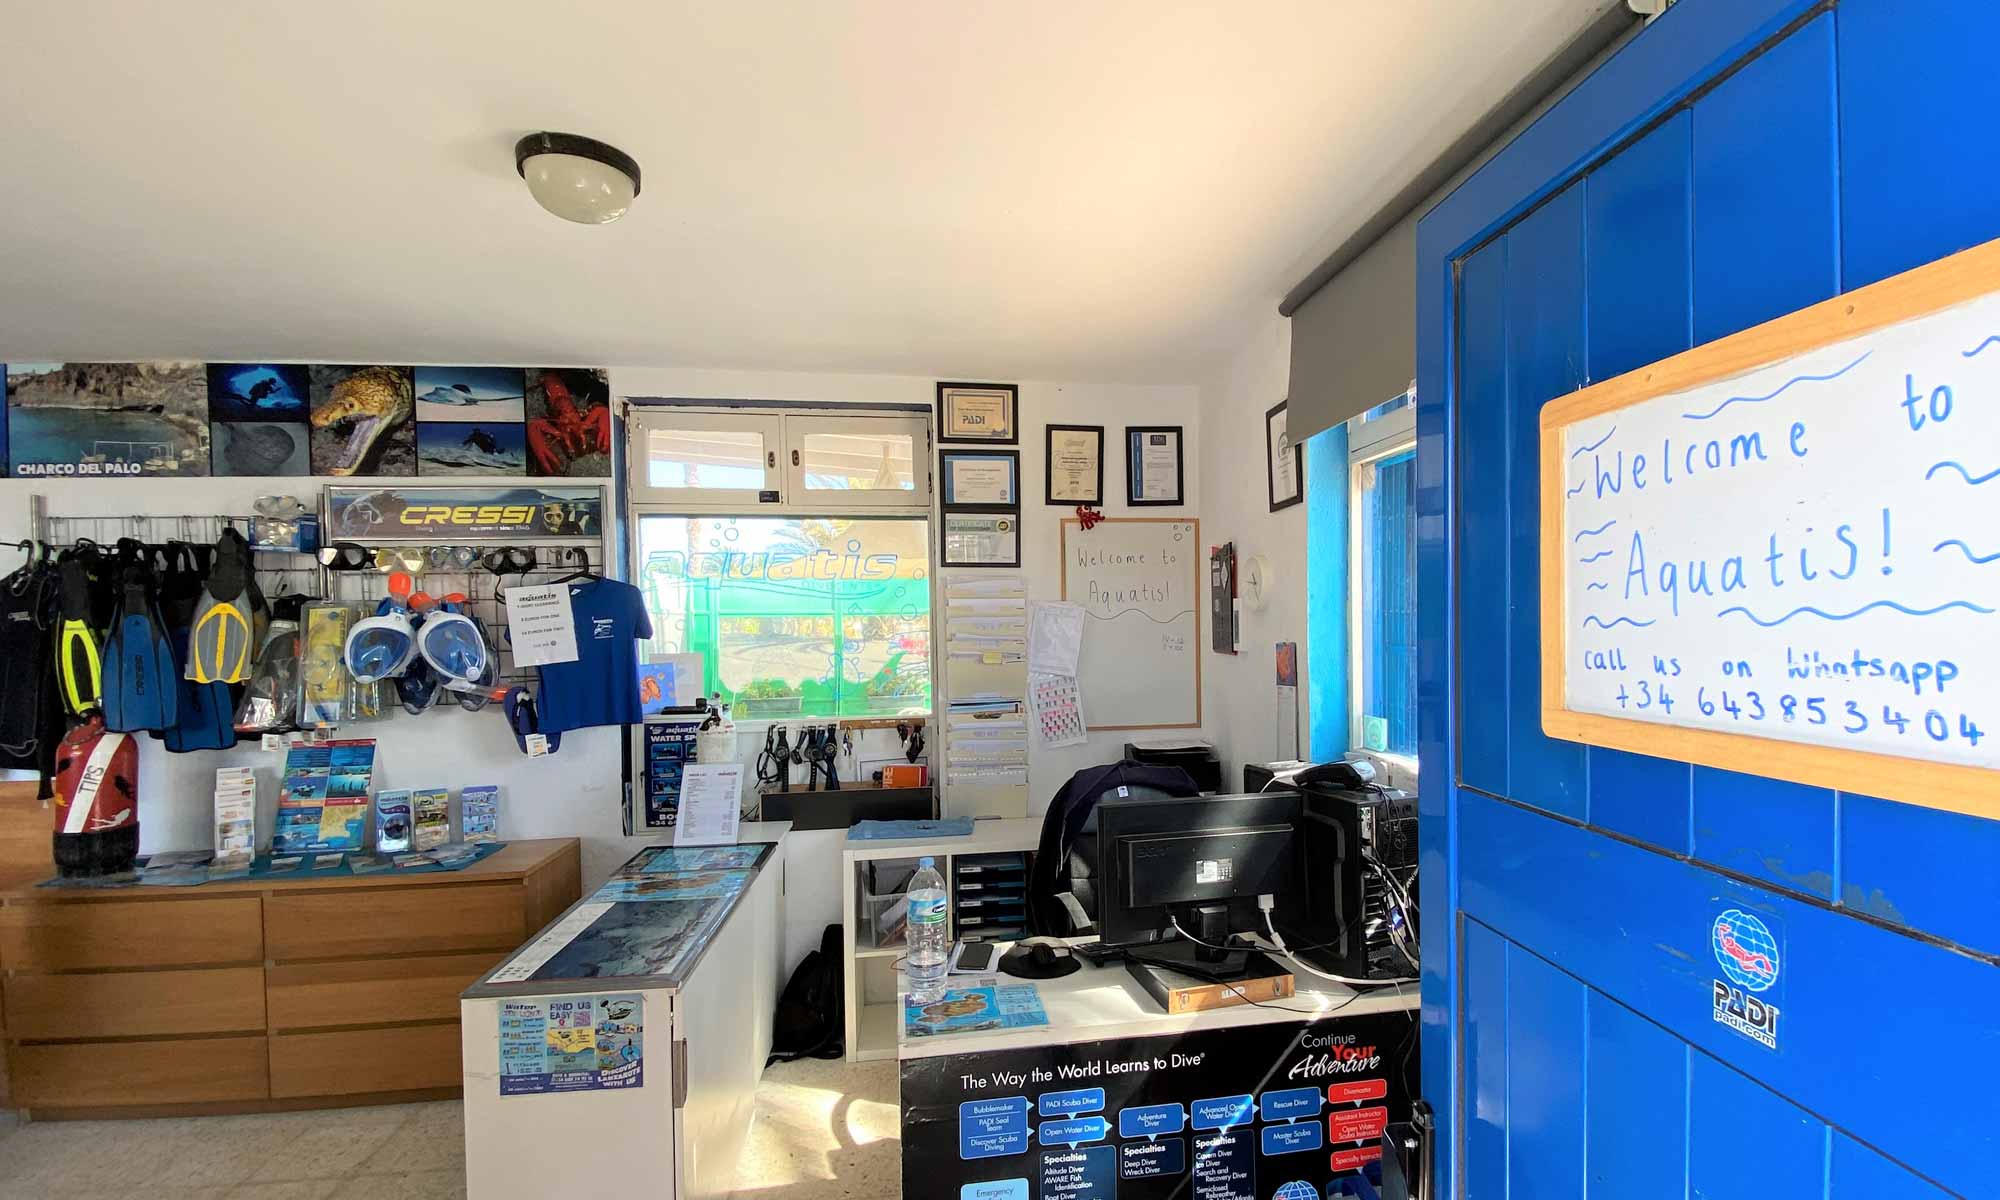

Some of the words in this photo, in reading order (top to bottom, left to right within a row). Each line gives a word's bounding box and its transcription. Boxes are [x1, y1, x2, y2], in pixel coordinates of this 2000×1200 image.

[962, 415, 986, 425] PADI
[1595, 421, 1808, 500] Welcome
[1900, 374, 1953, 432] to
[17, 463, 75, 475] CHARCO
[78, 463, 102, 474] DEL
[105, 462, 142, 474] PALO
[400, 506, 536, 524] CRESSI
[1077, 548, 1146, 567] Welcome
[1162, 548, 1176, 564] to
[643, 547, 899, 584] aquatis
[1088, 580, 1170, 612] Aquatis!
[1653, 655, 1682, 677] us
[1722, 660, 1753, 678] on
[1615, 680, 1675, 715] +34
[650, 735, 682, 743] WATER
[78, 765, 104, 793] TIPS
[550, 1002, 573, 1011] FIND
[577, 1001, 592, 1010] US
[1714, 980, 1777, 1036] PADI
[550, 1010, 572, 1020] EASY
[1714, 1010, 1776, 1049] padi.com
[1301, 1033, 1356, 1048] Continue
[1331, 1044, 1377, 1061] Your
[600, 1060, 638, 1077] DISCOVER
[1288, 1053, 1381, 1080] Adventure
[960, 1073, 987, 1089] The
[991, 1071, 1027, 1089] Way
[1031, 1066, 1053, 1083] the
[1057, 1060, 1101, 1079] World
[1105, 1059, 1150, 1074] Learns
[1153, 1057, 1167, 1070] to
[625, 1076, 636, 1085] US
[973, 1104, 1014, 1114] Bubblemaker
[1045, 1100, 1060, 1109] PADI
[1061, 1098, 1081, 1107] Scuba
[1082, 1097, 1098, 1105] Diver
[1273, 1101, 1293, 1109] Rescue
[1293, 1099, 1308, 1107] Diver
[1199, 1104, 1229, 1115] Advanced
[1206, 1111, 1224, 1120] Water
[978, 1118, 994, 1126] PADI
[995, 1115, 1009, 1124] Seal
[1137, 1113, 1167, 1121] Adventure
[1044, 1128, 1063, 1137] Open
[1063, 1126, 1083, 1134] Water
[1084, 1124, 1100, 1133] Diver
[1341, 1125, 1358, 1133] Open
[1359, 1121, 1376, 1131] Water
[970, 1138, 997, 1146] Discover
[998, 1134, 1018, 1143] Scuba
[1273, 1132, 1293, 1140] Master
[1293, 1128, 1312, 1138] Scuba
[1195, 1135, 1237, 1150] Specialties
[1285, 1137, 1300, 1145] Diver
[984, 1144, 1005, 1152] Diving
[1124, 1144, 1166, 1157] Specialties
[1217, 1150, 1233, 1158] Diver
[1044, 1152, 1088, 1166] Specialties
[1124, 1160, 1141, 1169] Deep
[1141, 1158, 1157, 1166] Diver
[1205, 1160, 1221, 1168] Diver
[1335, 1154, 1359, 1165] Specialty
[1044, 1167, 1068, 1176] Altitude
[1068, 1165, 1085, 1174] Diver
[1124, 1167, 1145, 1176] Wreck
[1144, 1166, 1161, 1174] Diver
[1196, 1167, 1216, 1177] Search
[1216, 1166, 1229, 1175] and
[1044, 1175, 1069, 1185] AWARE
[1069, 1173, 1082, 1182] Fish
[1205, 1174, 1232, 1183] Recovery
[1232, 1171, 1248, 1180] Diver
[1054, 1181, 1093, 1191] Identification
[976, 1188, 1015, 1198] Emergency
[1060, 1192, 1076, 1200] Diver
[1205, 1189, 1237, 1200] Rebreather
